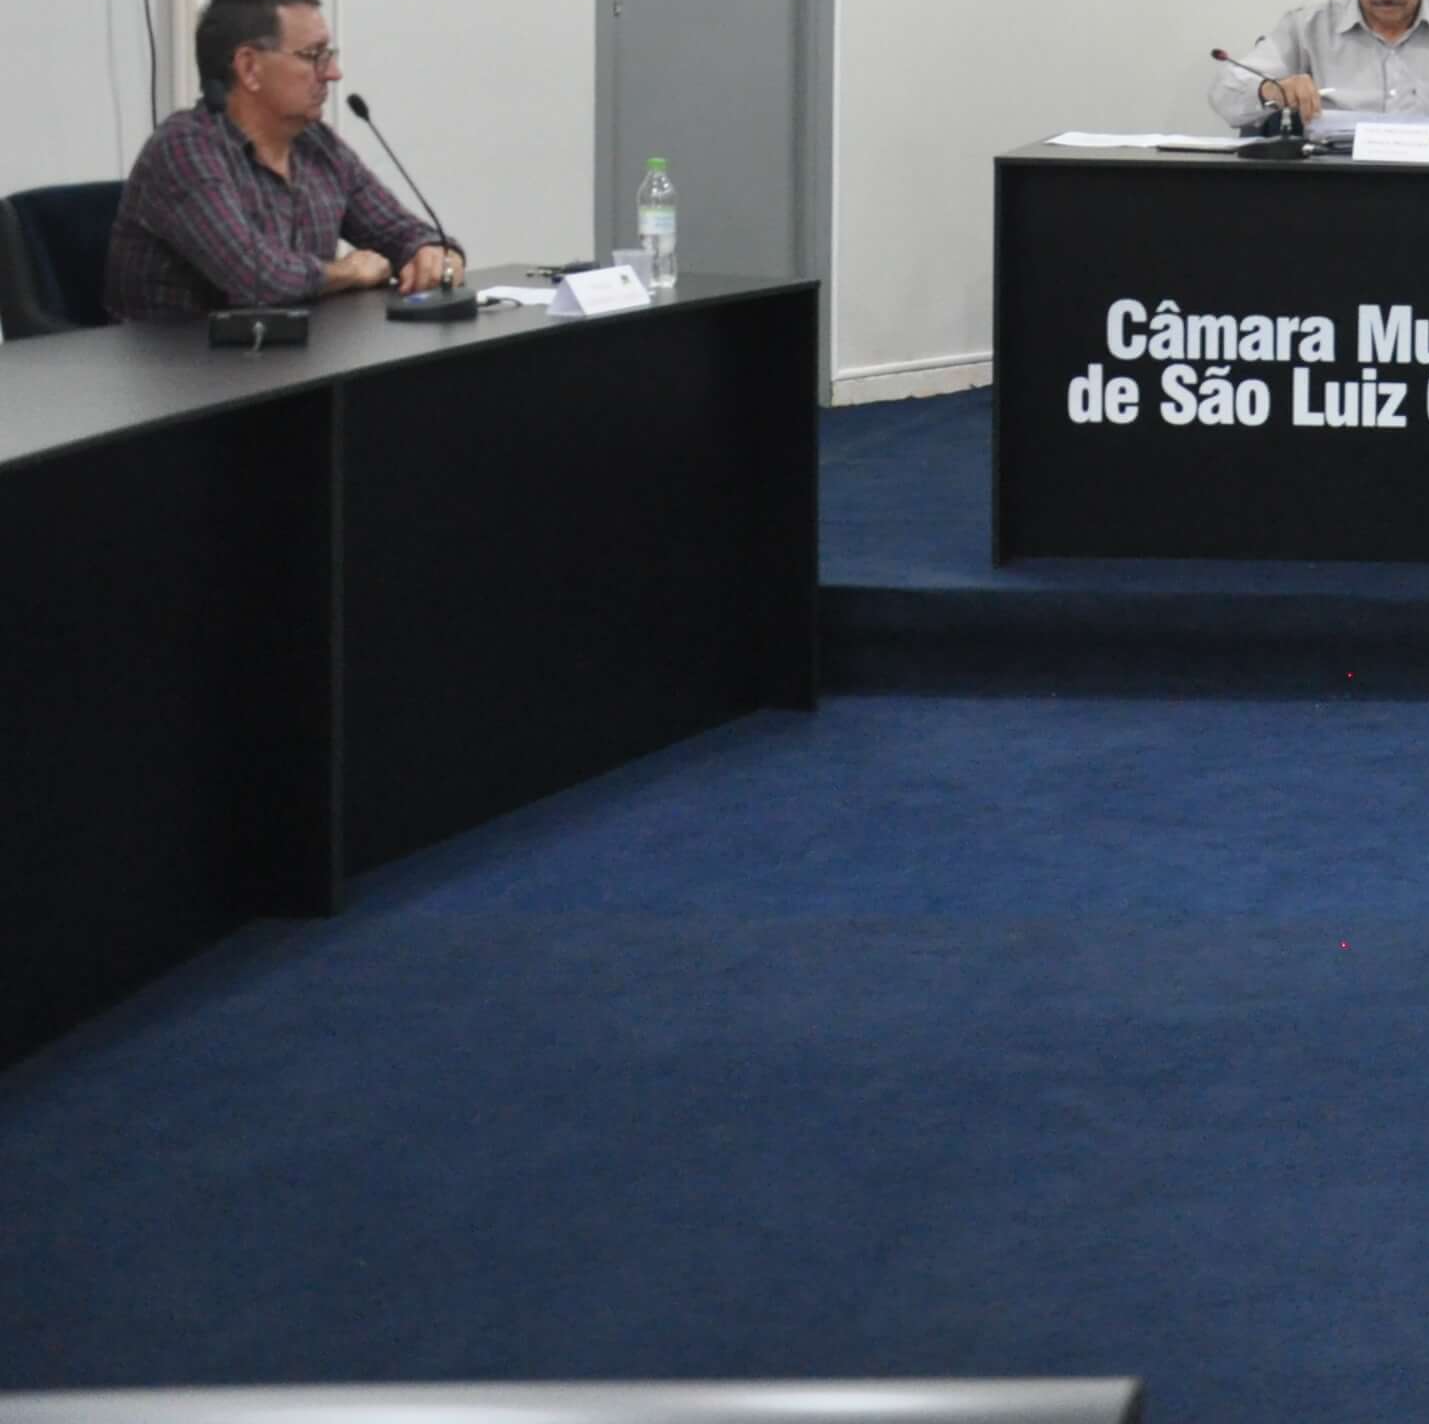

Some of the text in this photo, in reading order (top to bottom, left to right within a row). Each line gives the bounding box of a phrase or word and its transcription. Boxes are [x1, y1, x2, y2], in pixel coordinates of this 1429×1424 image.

[1106, 298, 1335, 363] Câmara
[1067, 363, 1140, 425] de
[1160, 363, 1271, 427] São
[1292, 366, 1408, 428] Luiz
